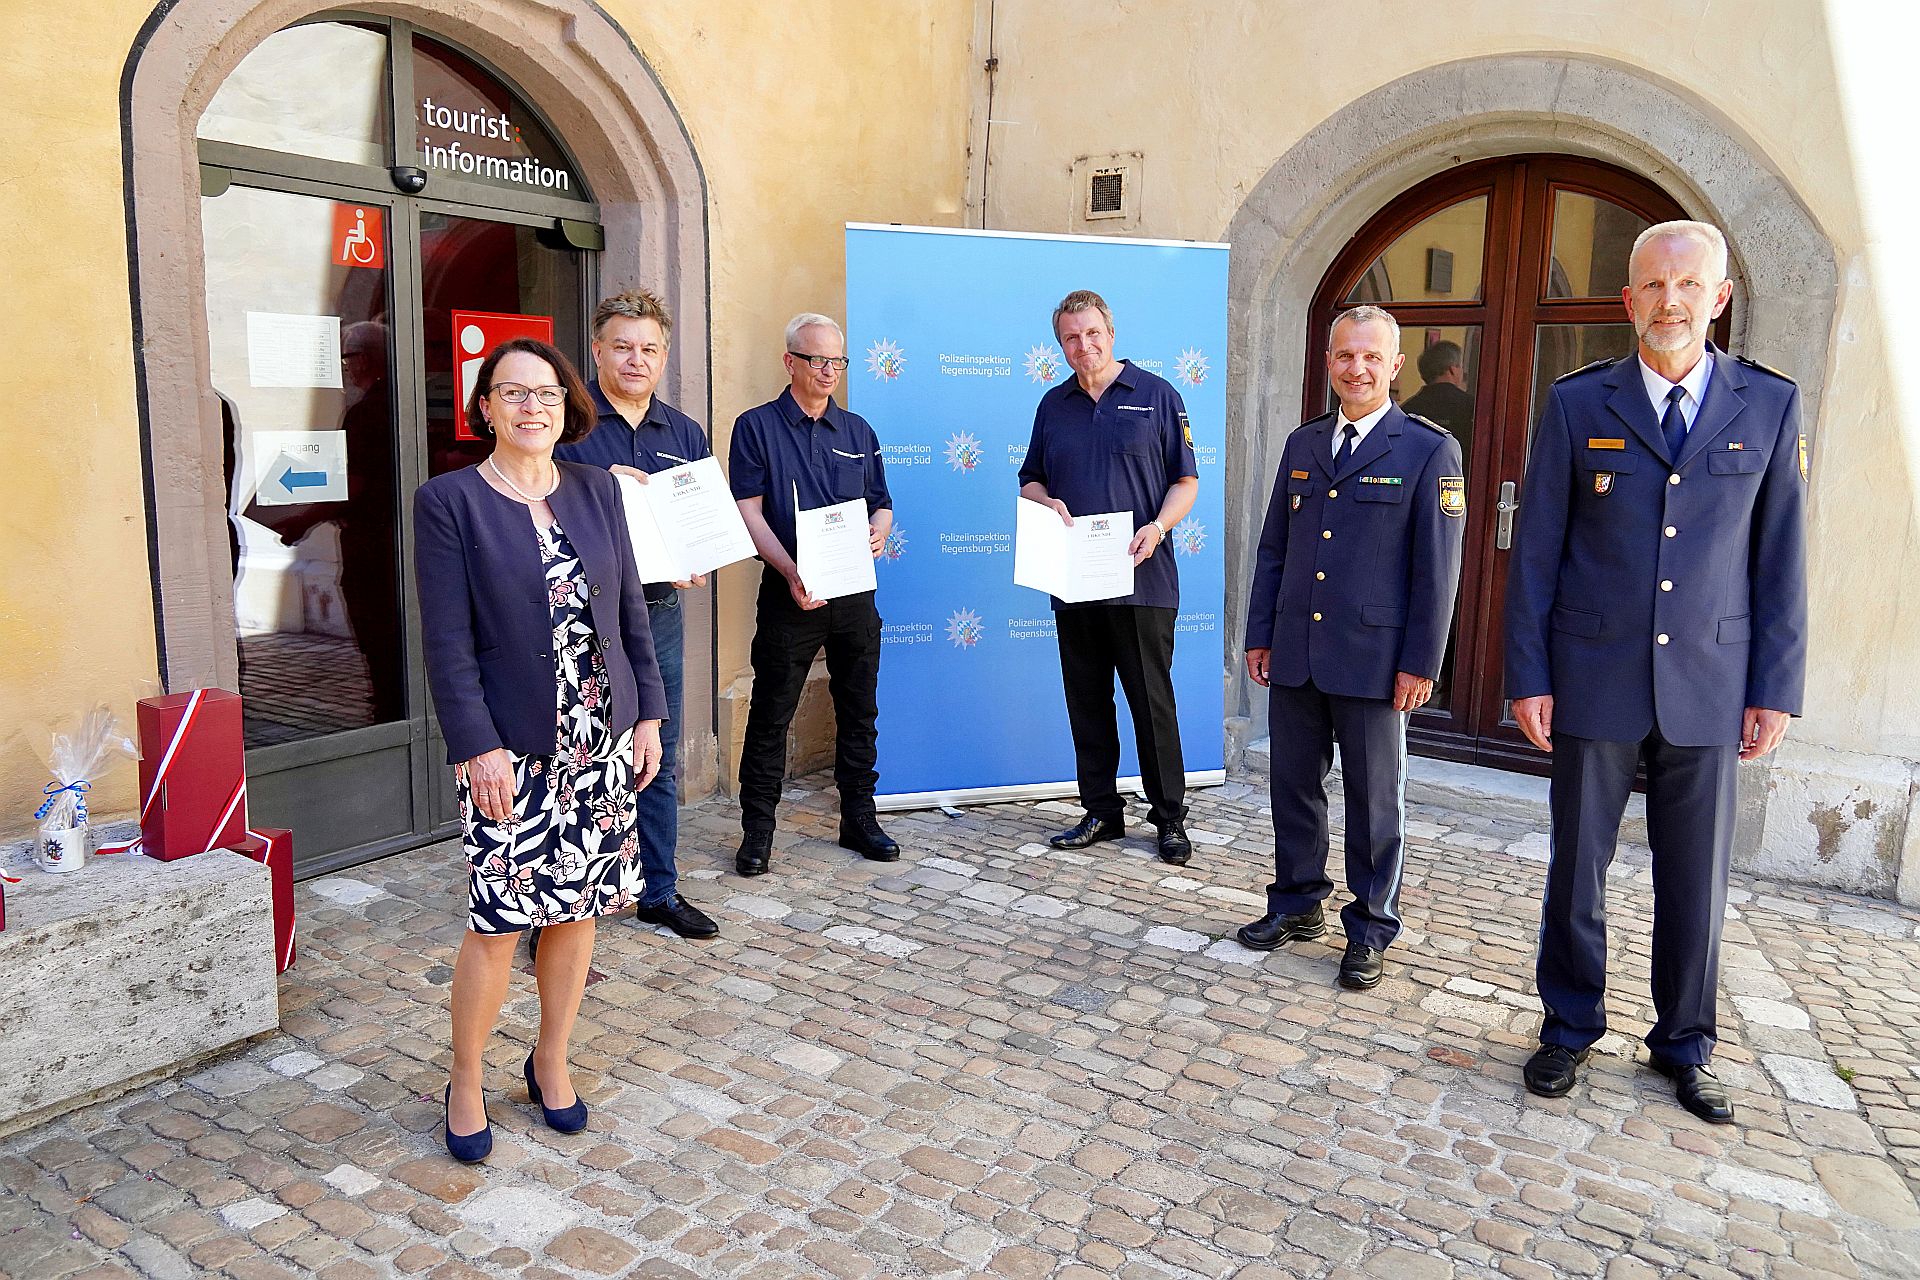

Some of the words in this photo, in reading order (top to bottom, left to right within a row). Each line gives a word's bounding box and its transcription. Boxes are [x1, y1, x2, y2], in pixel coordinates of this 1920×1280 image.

[424, 137, 569, 191] information
[939, 353, 1011, 366] Polizeiinspektion
[941, 365, 993, 378] Regensburg
[994, 366, 1011, 376] Süd
[281, 442, 320, 454] Eingang
[879, 443, 932, 455] eiinspektion
[881, 455, 912, 467] nsburg
[914, 456, 931, 465] Süd
[1201, 455, 1216, 465] Süd
[940, 532, 1011, 544] Polizeiinspektion
[941, 544, 992, 555] Regensburg
[993, 543, 1010, 552] Süd
[880, 622, 933, 634] eiinspektion
[1008, 618, 1057, 628] Polizeiinspe
[1199, 622, 1215, 631] Süd
[915, 633, 933, 642] Süd
